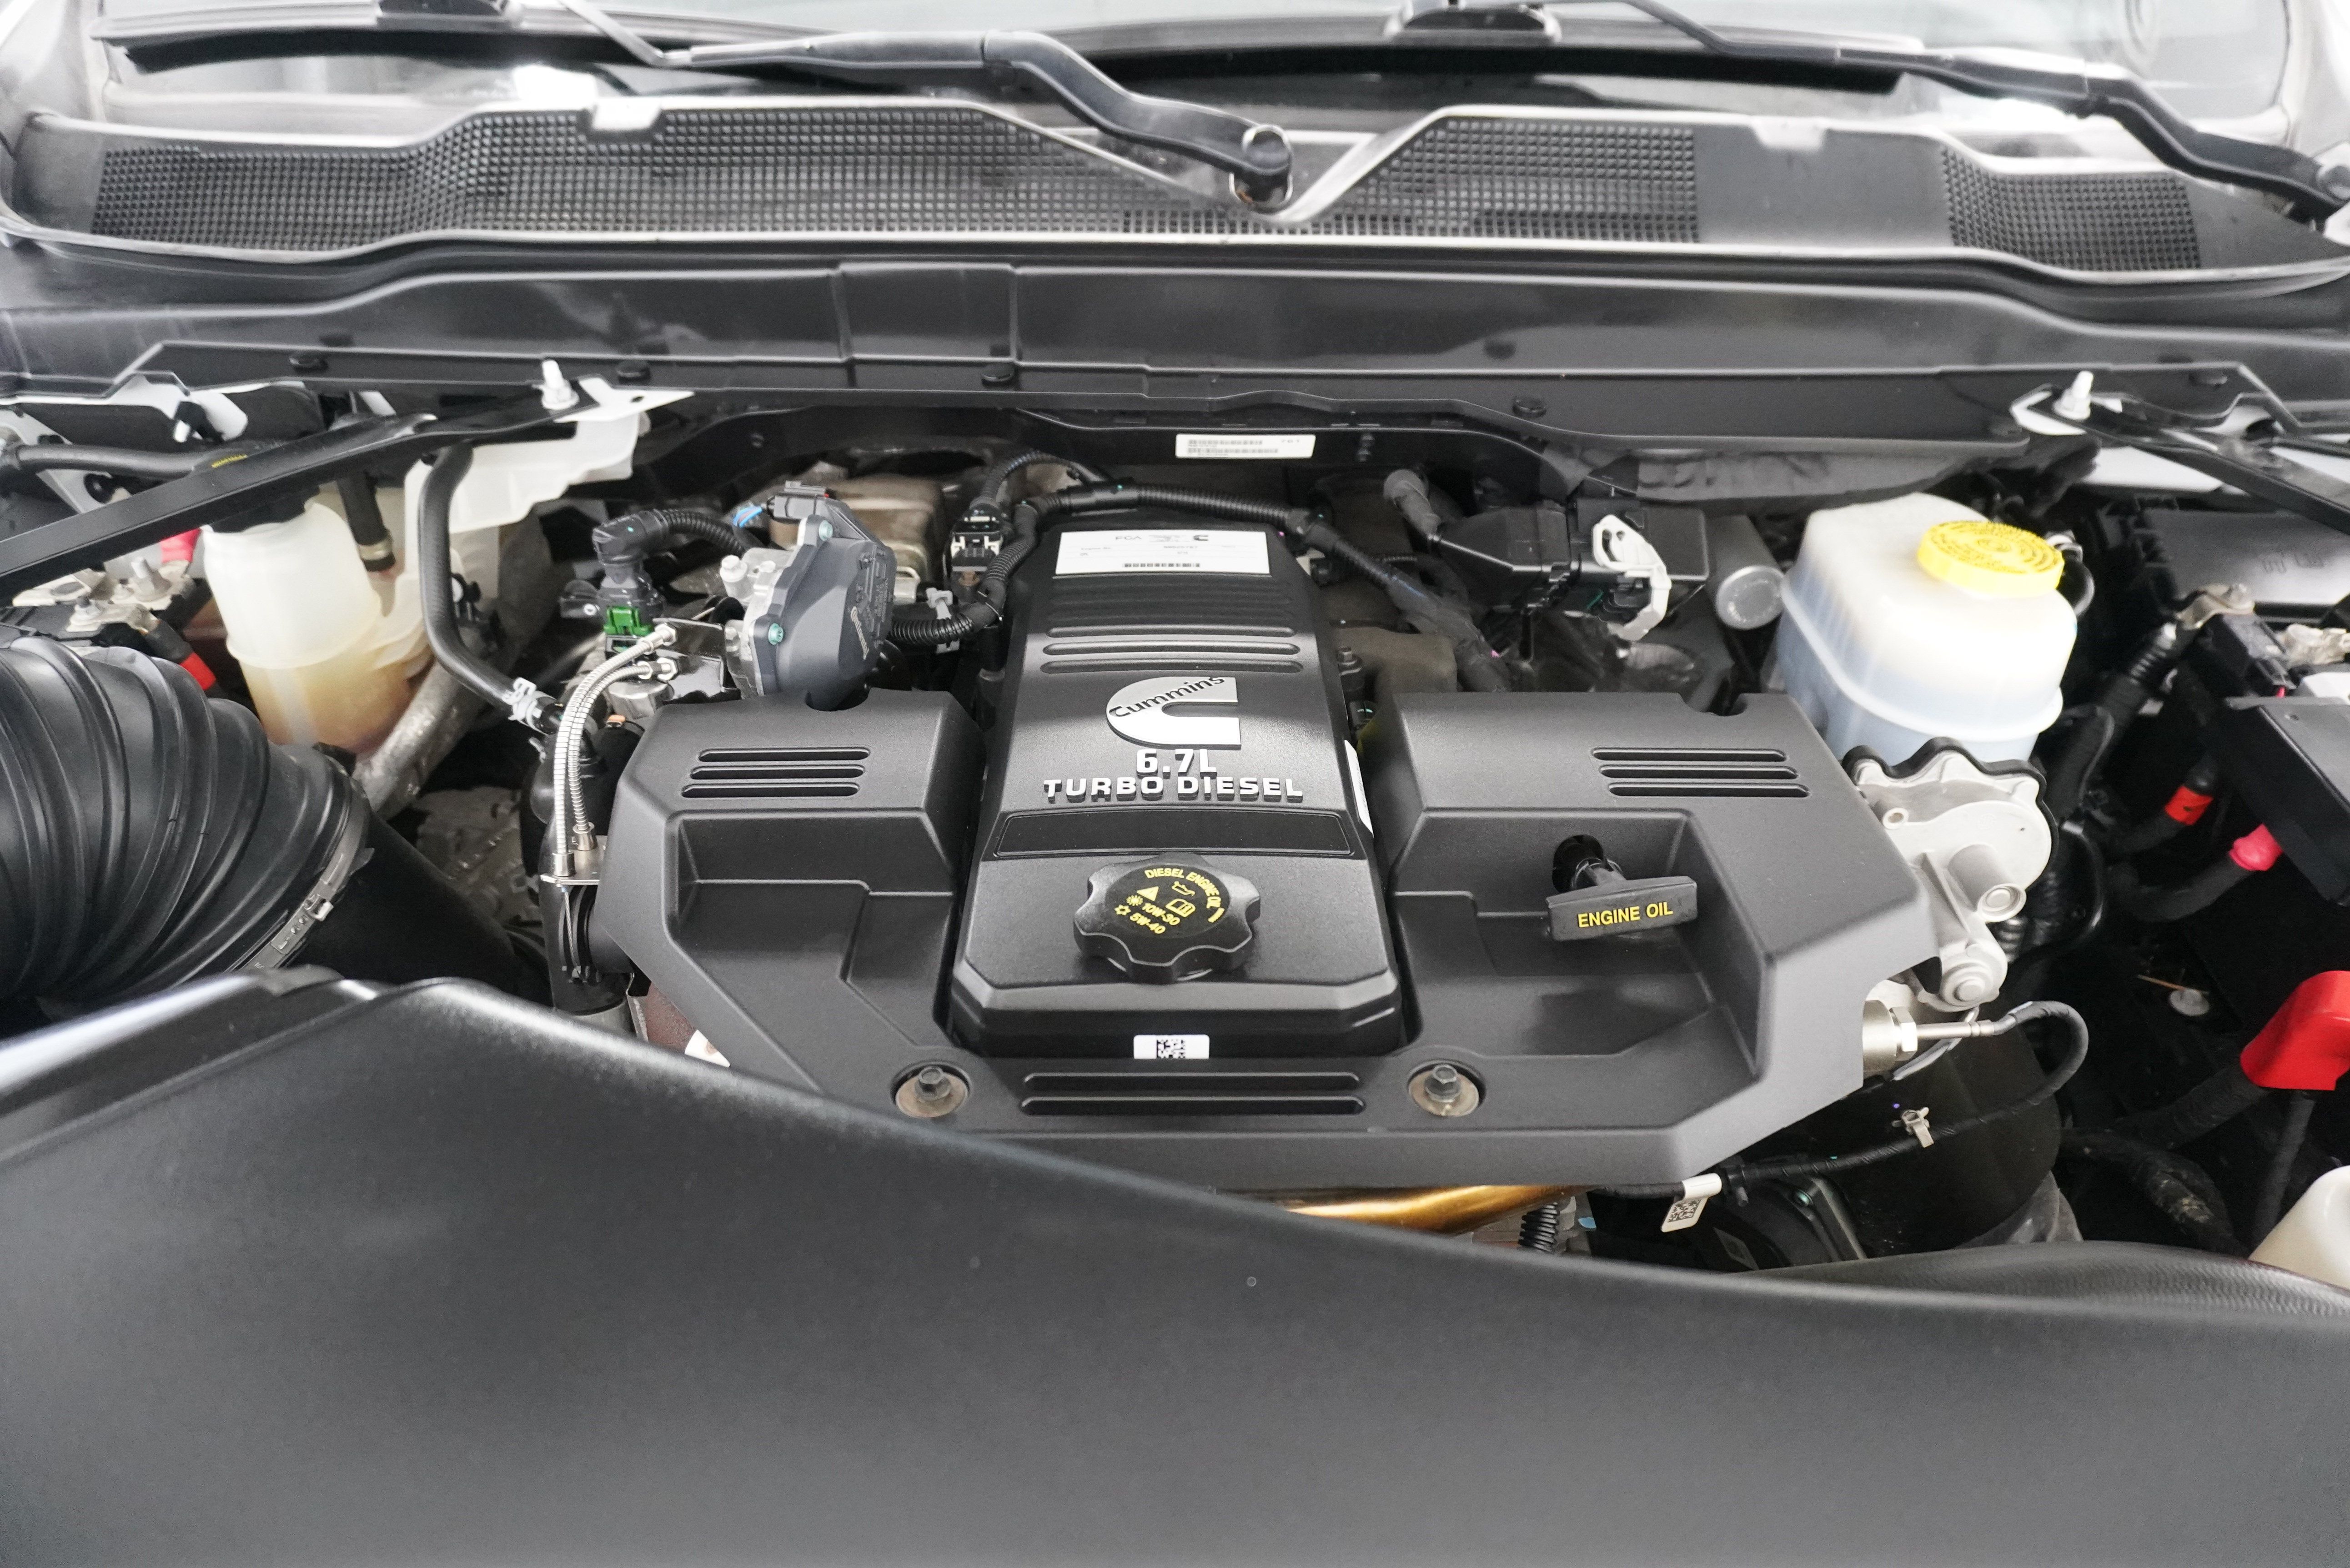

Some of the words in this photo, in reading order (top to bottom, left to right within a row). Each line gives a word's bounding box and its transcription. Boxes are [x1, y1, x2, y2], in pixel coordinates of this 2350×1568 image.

[850, 606, 869, 660] Continental
[1136, 749, 1217, 778] 6.7L
[1043, 776, 1164, 804] TURBO
[1177, 776, 1304, 803] DIESEL
[1144, 868, 1185, 879] DIESEL
[1185, 871, 1220, 897] ENGINE
[1206, 896, 1221, 909] OIL
[1130, 912, 1166, 934] 5W-40
[1142, 902, 1181, 926] 10W-30
[1577, 905, 1641, 928] ENGINE
[1646, 901, 1674, 918] OIL
